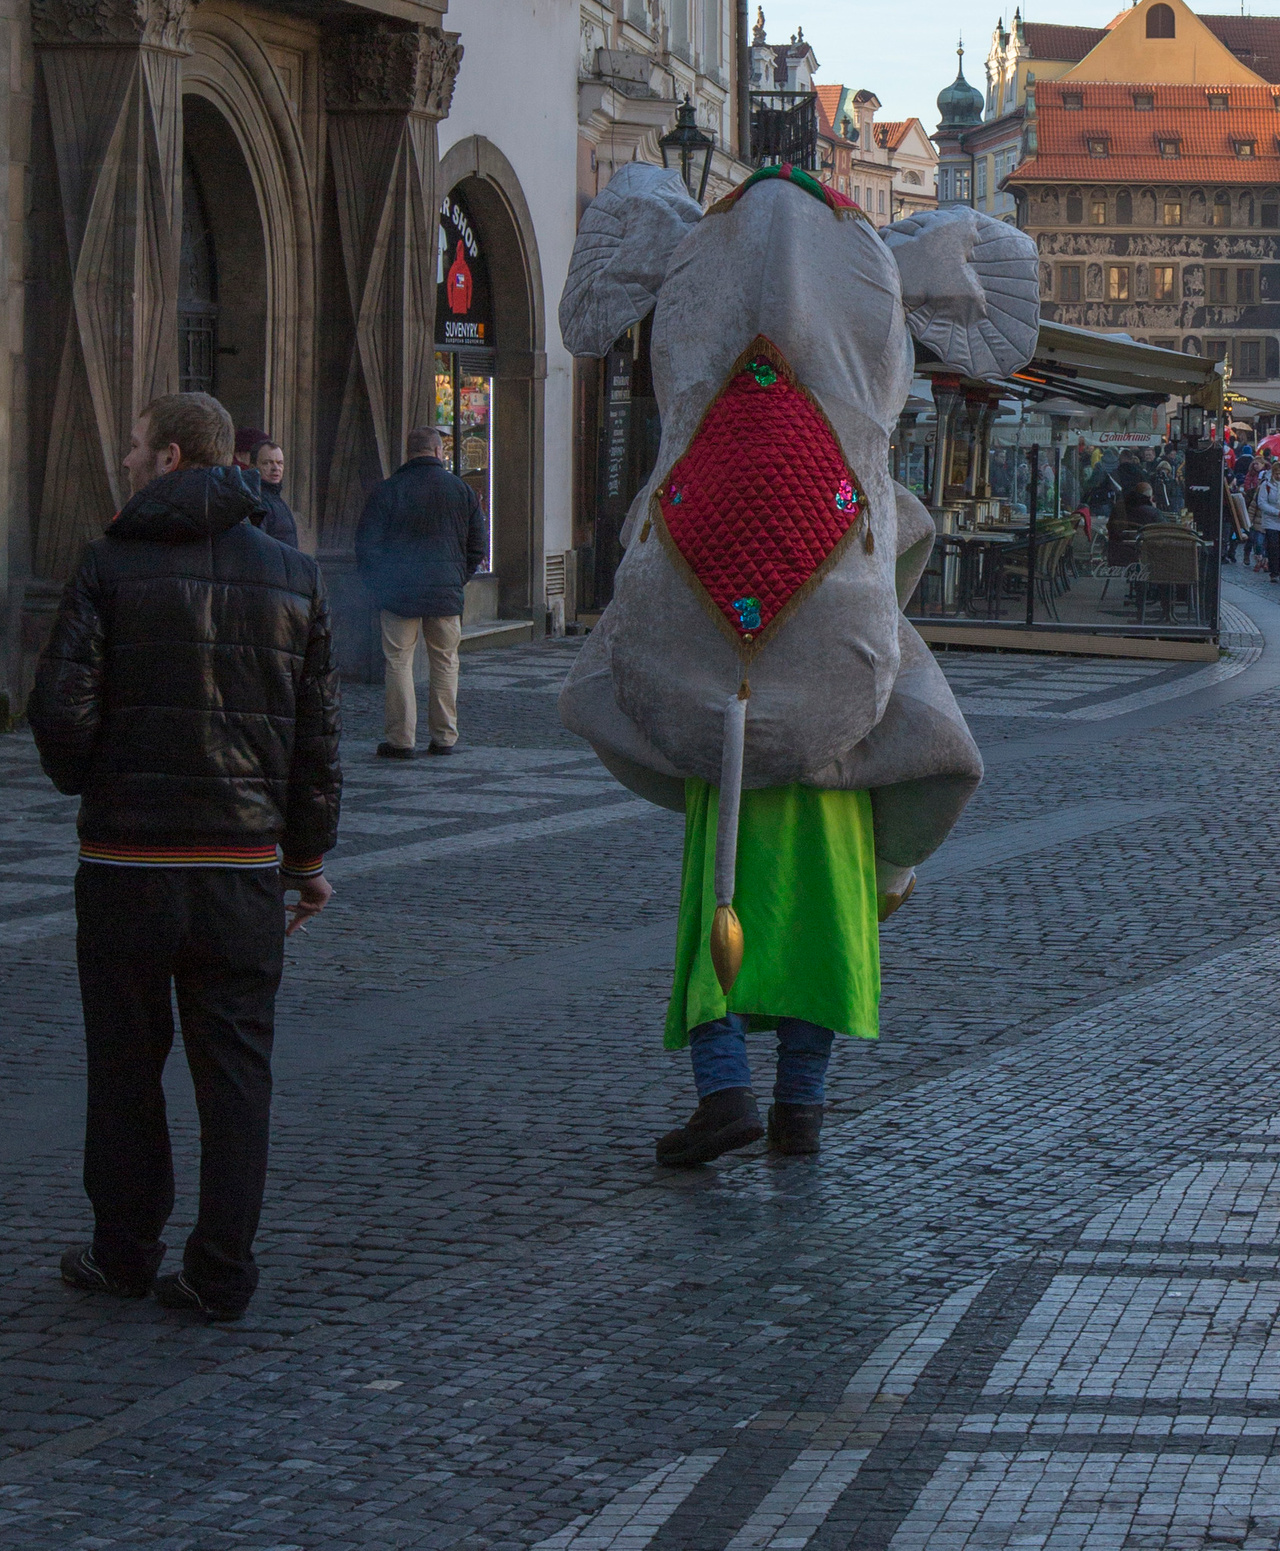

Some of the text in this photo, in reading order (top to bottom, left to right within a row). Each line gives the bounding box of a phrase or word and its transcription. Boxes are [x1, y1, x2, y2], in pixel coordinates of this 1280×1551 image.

[440, 197, 450, 217] R
[452, 204, 478, 257] SHOP
[1100, 431, 1151, 443] Gambrinus
